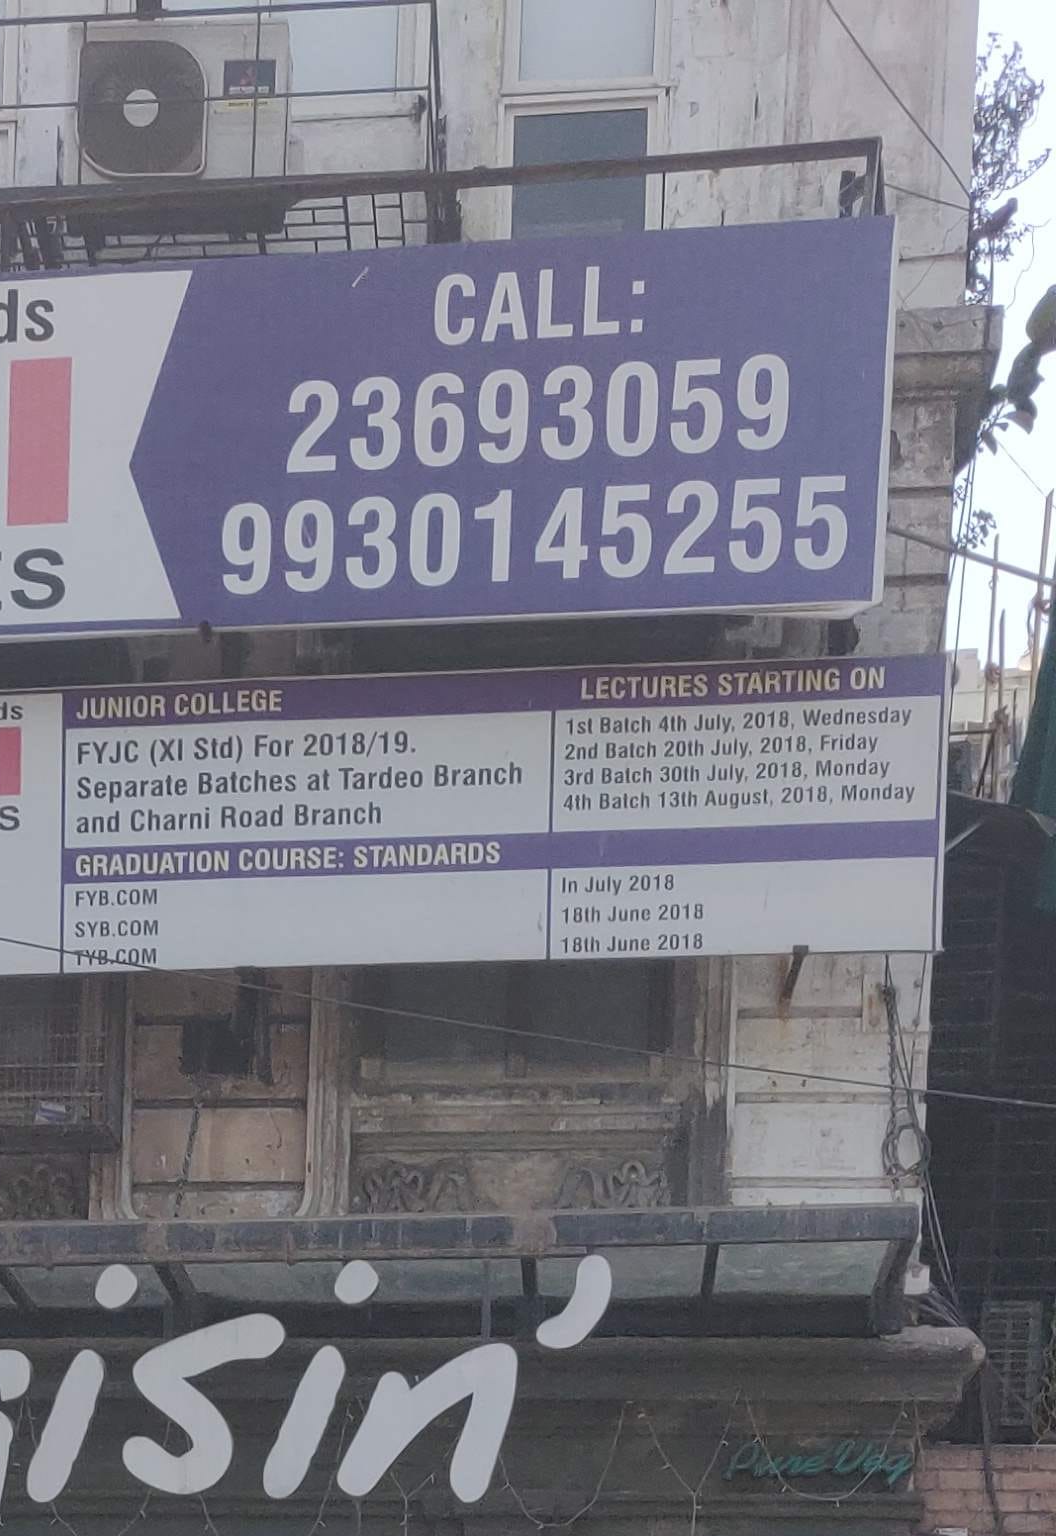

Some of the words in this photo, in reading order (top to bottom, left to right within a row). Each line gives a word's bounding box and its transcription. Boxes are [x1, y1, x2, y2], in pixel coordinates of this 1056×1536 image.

[433, 265, 646, 346] CALL:
[287, 354, 789, 472] 23693059
[221, 475, 847, 594] 9930145255
[581, 674, 708, 699] LECTURES
[718, 670, 840, 696] STARTING
[850, 667, 885, 689] ON
[76, 695, 165, 720] JUNIOR
[174, 689, 282, 716] COLLEGE
[565, 718, 593, 735] 1st
[600, 716, 651, 734] Batch
[659, 716, 686, 733] 4th
[694, 712, 735, 733] July,
[744, 711, 794, 730] 2018,
[803, 707, 912, 727] Wednesday
[77, 740, 139, 765] FYJC
[150, 737, 183, 765] (XI
[194, 735, 243, 764] Std)
[254, 734, 293, 758] For
[304, 731, 416, 758] 2018/19.
[565, 742, 598, 760] 2nd
[606, 741, 657, 759] Batch
[664, 740, 704, 758] 20th
[711, 738, 752, 759] July,
[760, 736, 812, 755] 2018,
[820, 735, 878, 755] Friday
[77, 775, 187, 802] Separate
[198, 769, 296, 795] Batches
[307, 770, 330, 791] at
[338, 766, 423, 790] Tardeo
[434, 762, 522, 787] Branch
[563, 768, 594, 785] 3rd
[601, 766, 652, 784] Batch
[660, 766, 700, 783] 30th
[706, 763, 748, 783] July,
[755, 762, 807, 780] 2018,
[815, 760, 890, 779] Monday
[563, 794, 591, 811] 4th
[599, 792, 650, 809] Batch
[659, 790, 698, 808] 13th
[705, 789, 772, 810] August,
[781, 786, 832, 805] 2018,
[841, 784, 915, 803] Monday
[76, 811, 120, 833] and
[130, 806, 210, 832] Charni
[220, 805, 283, 829] Road
[294, 801, 382, 826] Branch
[75, 849, 229, 877] GRADUATION
[238, 846, 344, 871] COURSE:
[353, 842, 500, 867] STANDARDS
[75, 889, 158, 907] FYB.COM
[562, 877, 577, 893] In
[584, 875, 621, 896] July
[629, 874, 674, 891] 2018
[561, 906, 600, 924] 18th
[608, 905, 651, 922] June
[658, 904, 704, 921] 2018
[75, 920, 159, 939] SYB.COM
[561, 936, 600, 954] 18th
[607, 935, 650, 952] June
[658, 933, 703, 950] 2018
[76, 948, 157, 968] TYB.COM
